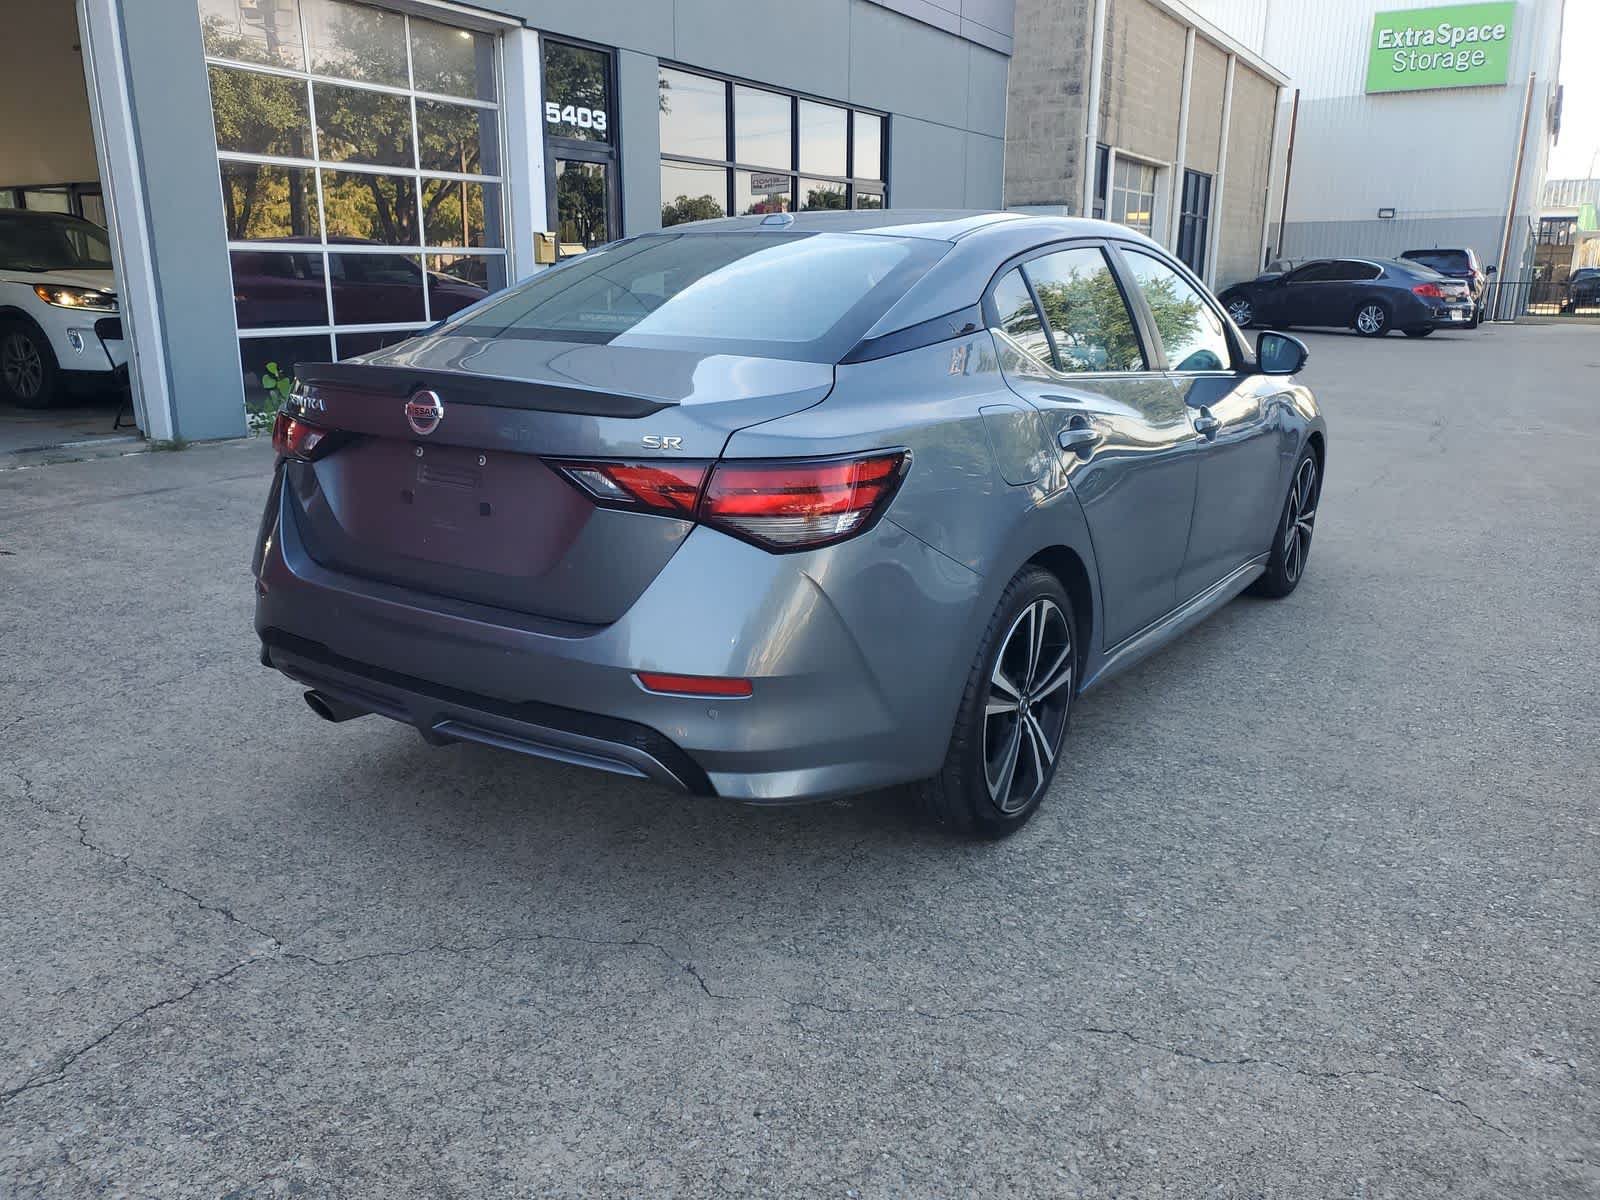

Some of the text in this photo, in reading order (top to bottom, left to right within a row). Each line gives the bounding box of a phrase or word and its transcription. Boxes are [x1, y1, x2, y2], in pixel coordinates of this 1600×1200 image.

[1392, 49, 1486, 72] Storage
[545, 102, 607, 131] 5403
[641, 435, 682, 450] SR
